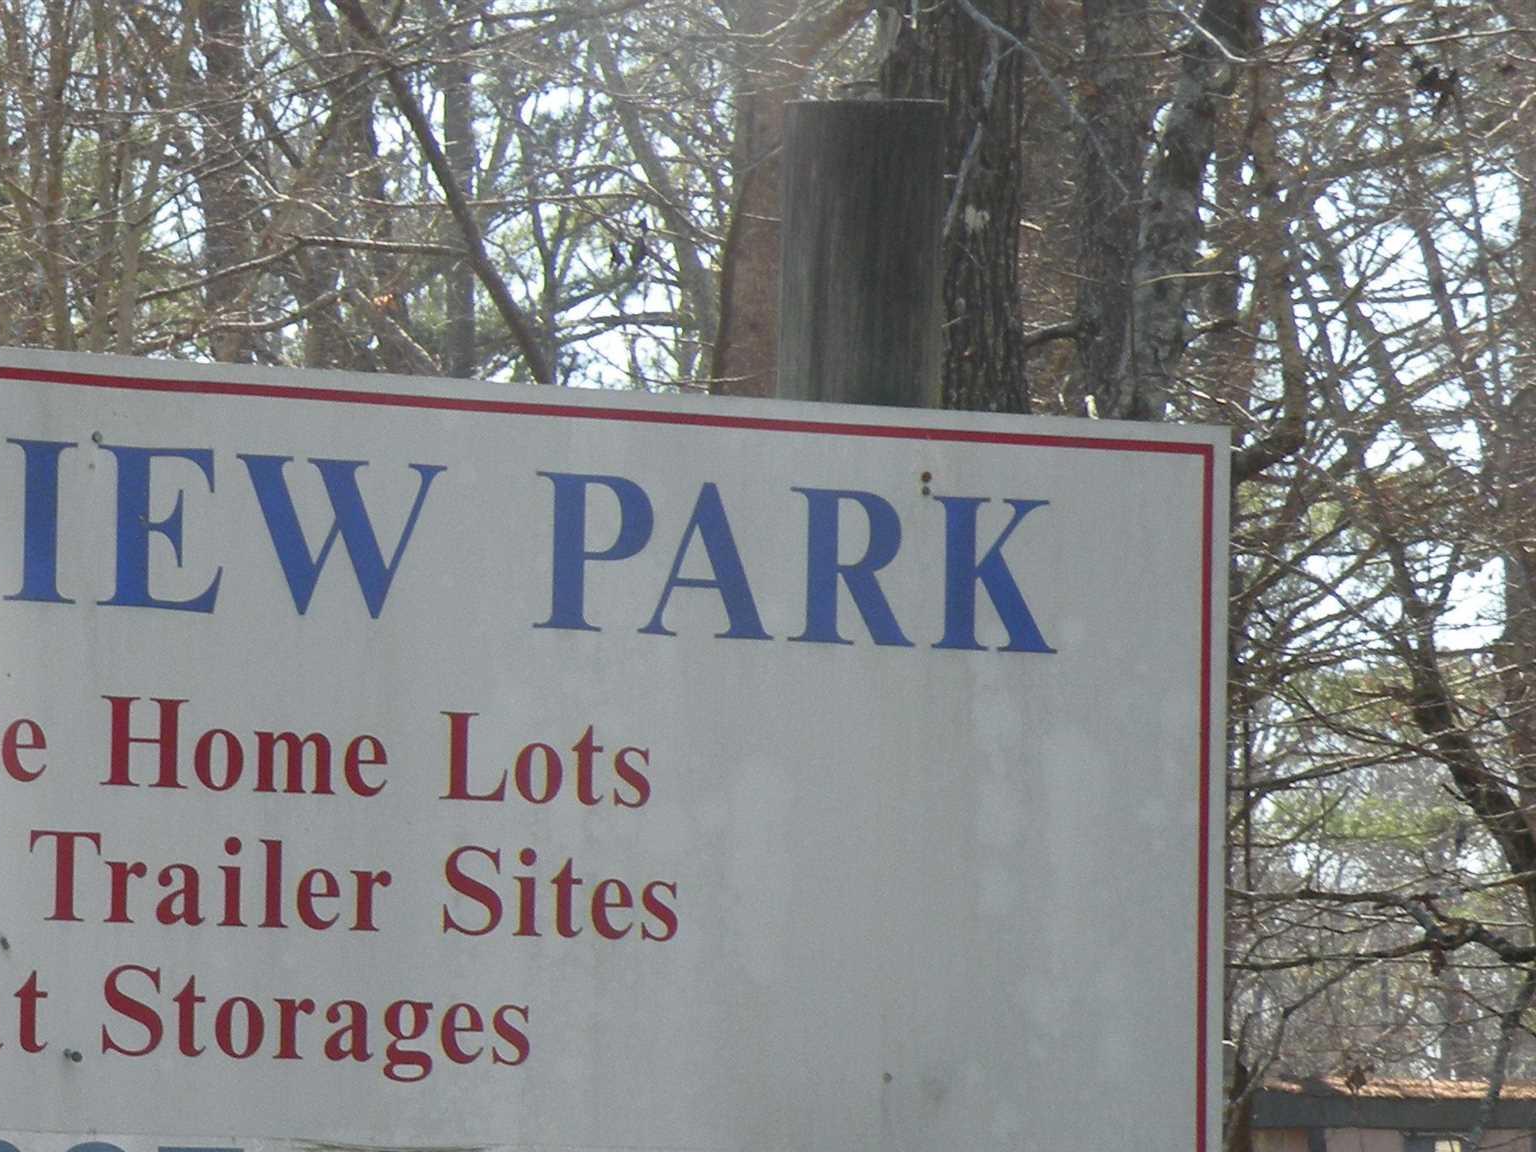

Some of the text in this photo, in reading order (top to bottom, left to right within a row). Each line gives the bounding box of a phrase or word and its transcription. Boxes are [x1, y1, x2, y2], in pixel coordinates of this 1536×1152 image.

[534, 470, 1057, 656] PARK
[101, 697, 388, 798] Home
[442, 711, 651, 808] Lots
[29, 830, 393, 932] Trailer
[444, 848, 680, 943] Sites
[102, 968, 531, 1080] Storages
